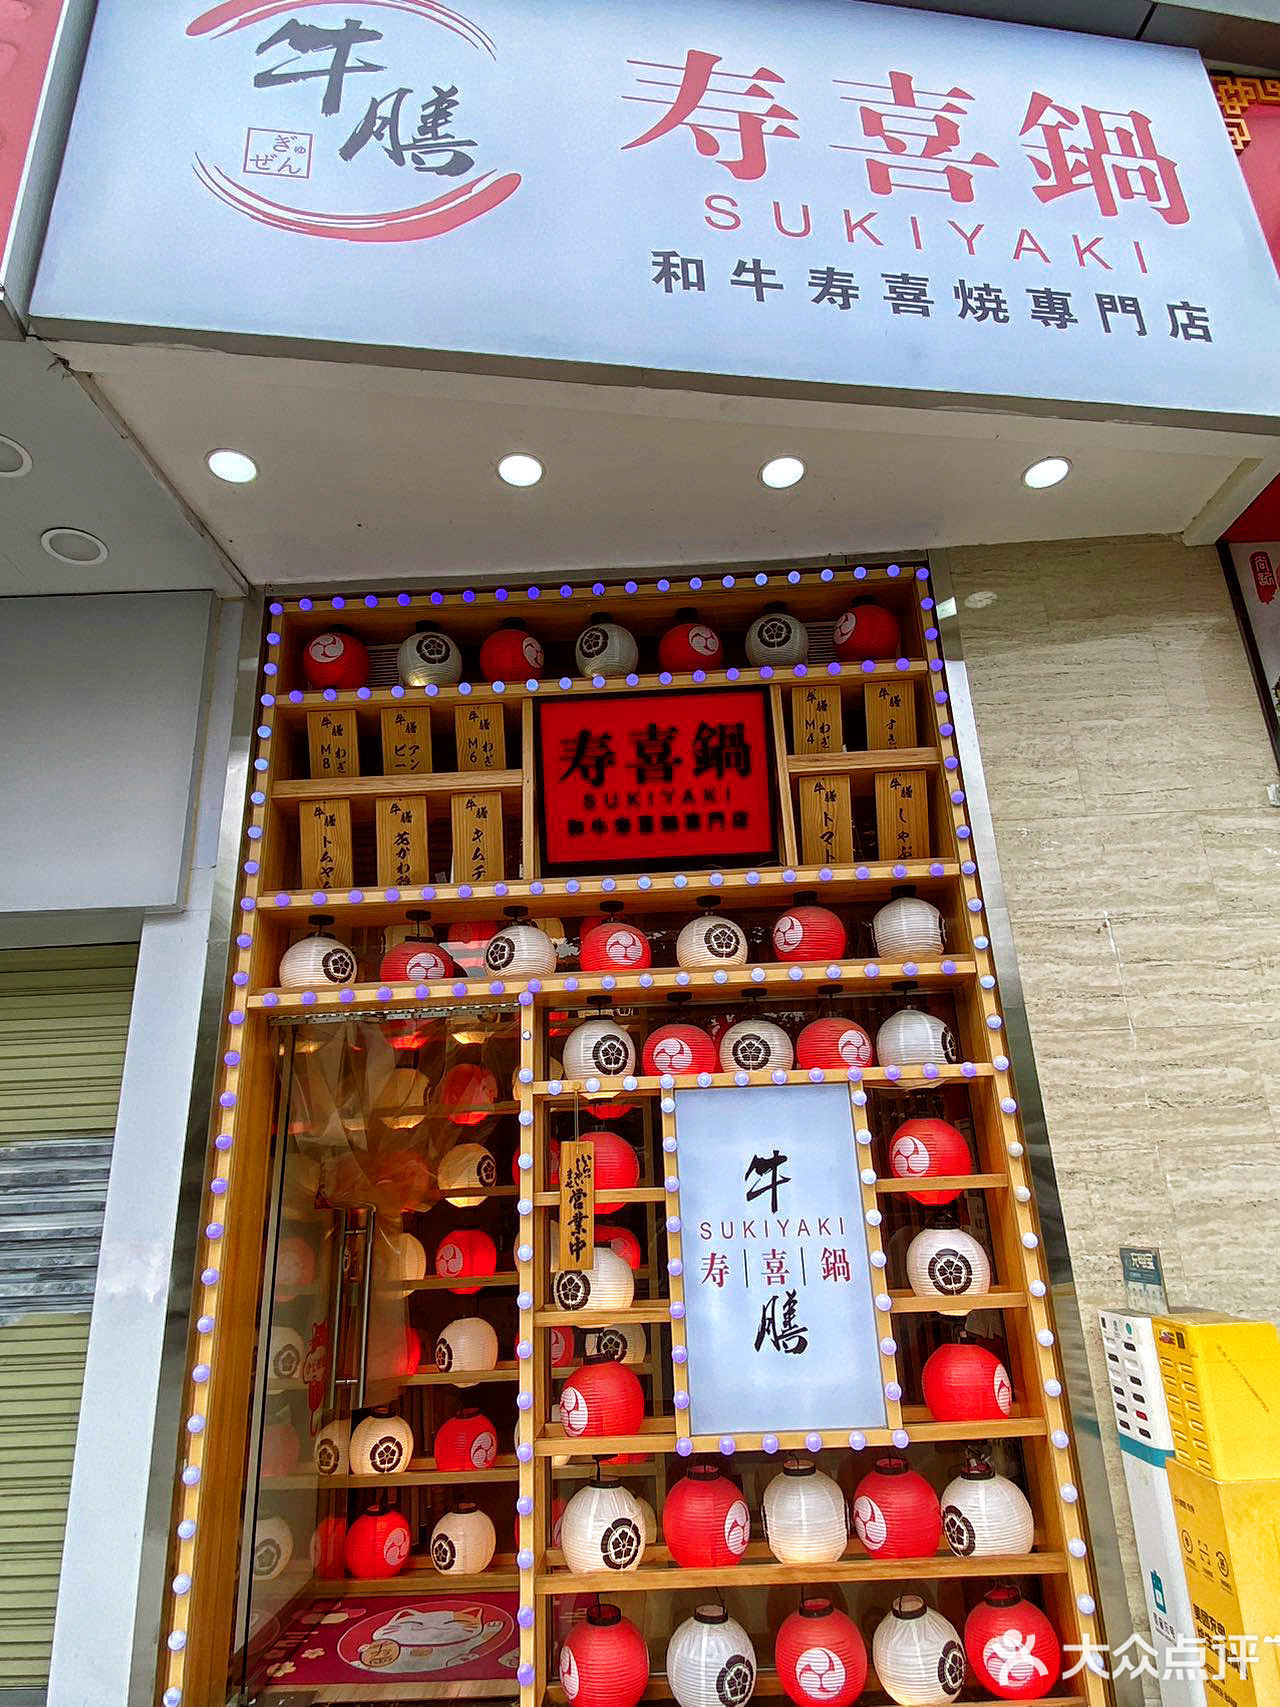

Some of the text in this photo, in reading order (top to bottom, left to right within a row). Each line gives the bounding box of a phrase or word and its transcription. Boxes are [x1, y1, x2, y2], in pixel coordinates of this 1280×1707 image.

[620, 49, 1191, 226] 寿喜鍋
[703, 193, 1149, 275] SUKIYAKI
[559, 720, 753, 786] 寿喜鍋
[583, 785, 732, 811] SUKIYAKI
[745, 1150, 792, 1215] 牛
[700, 1217, 845, 1241] SUKIYAKI
